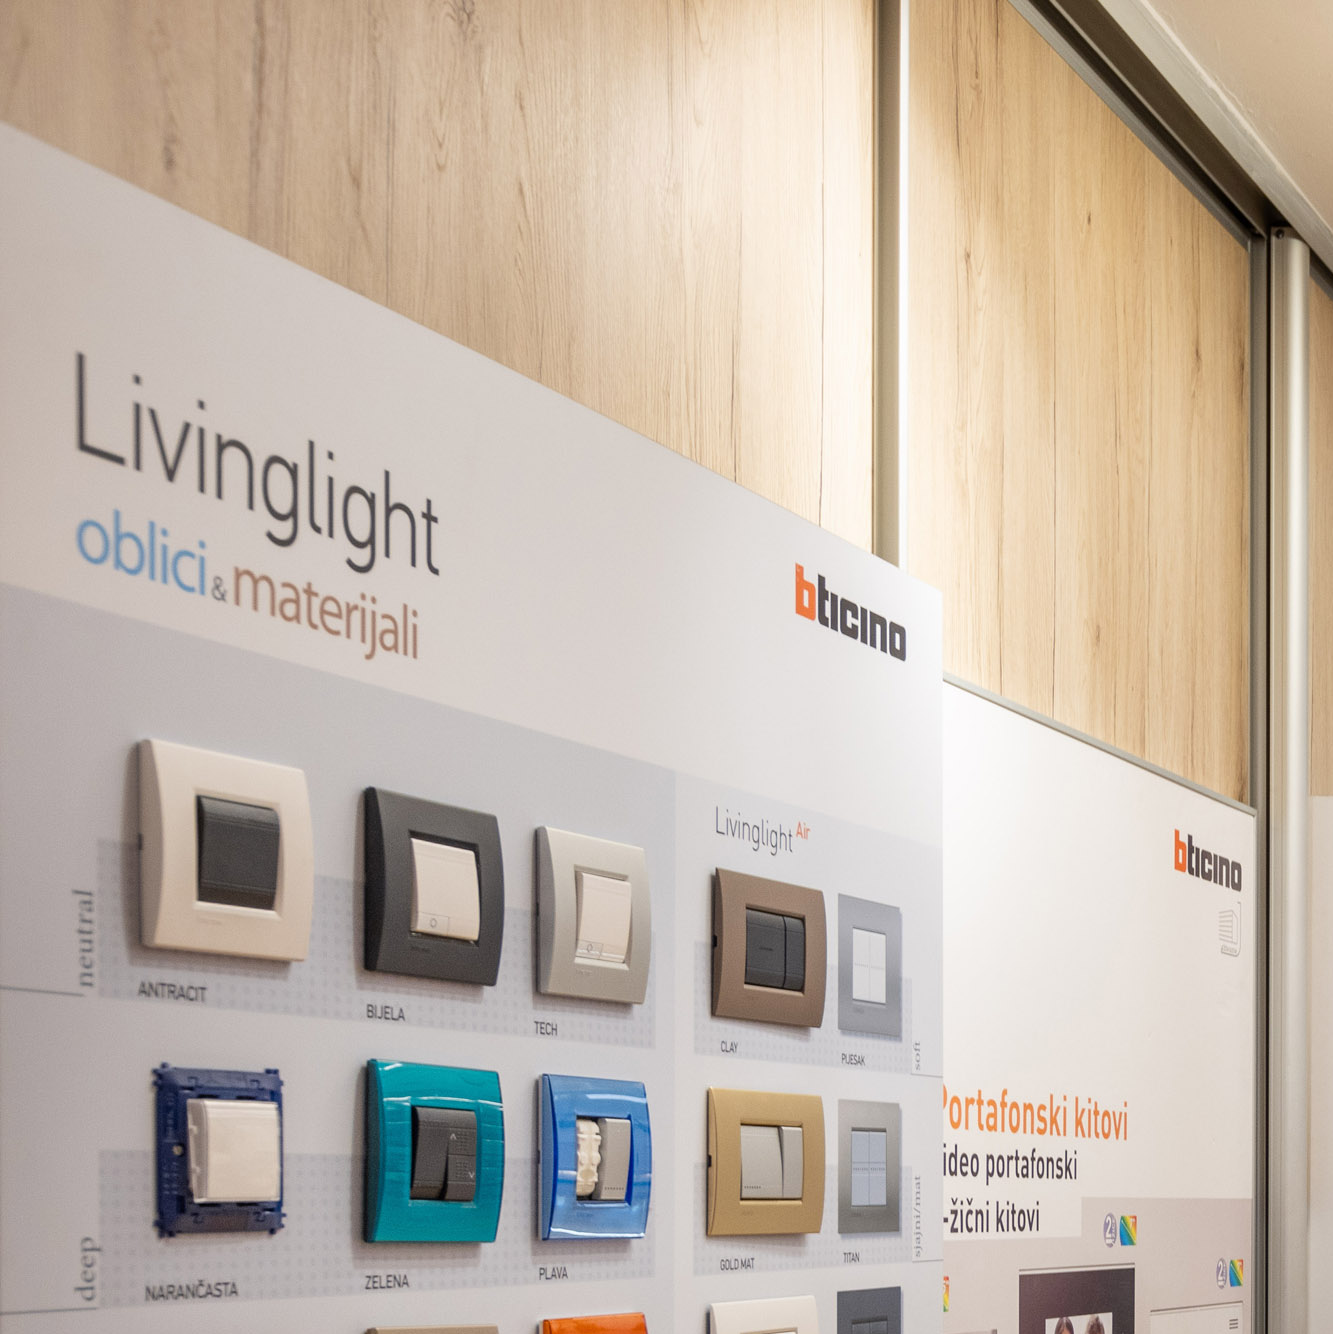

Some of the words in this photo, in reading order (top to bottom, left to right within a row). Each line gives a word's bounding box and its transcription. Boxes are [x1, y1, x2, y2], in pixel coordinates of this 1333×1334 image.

[76, 351, 440, 577] Livinglight
[76, 511, 206, 597] oblici
[211, 576, 227, 602] &
[233, 561, 418, 660] materijali
[795, 562, 906, 661] bticino
[715, 806, 793, 856] Livinglight
[796, 821, 810, 840] Air
[1174, 829, 1242, 892] bticino
[73, 889, 94, 988] neutral
[138, 981, 207, 1002] ANTRACIT
[366, 1004, 405, 1022] BIJELA
[534, 1021, 558, 1036] TECH
[721, 1041, 738, 1054] CLAY
[914, 1041, 922, 1071] soft
[1074, 1096, 1128, 1141] kitovi
[943, 1144, 979, 1178] ideo
[986, 1147, 1077, 1185] portafonski
[914, 1175, 922, 1257] sjajni/mat
[995, 1200, 1039, 1232] kitovi
[74, 1236, 102, 1301] deep
[539, 1266, 568, 1280] PLAVA
[720, 1259, 738, 1272] GOLD
[739, 1257, 755, 1270] MAT
[843, 1252, 860, 1264] TITAN
[145, 1279, 238, 1301] NARANČASTA
[365, 1274, 409, 1290] ZELENA
